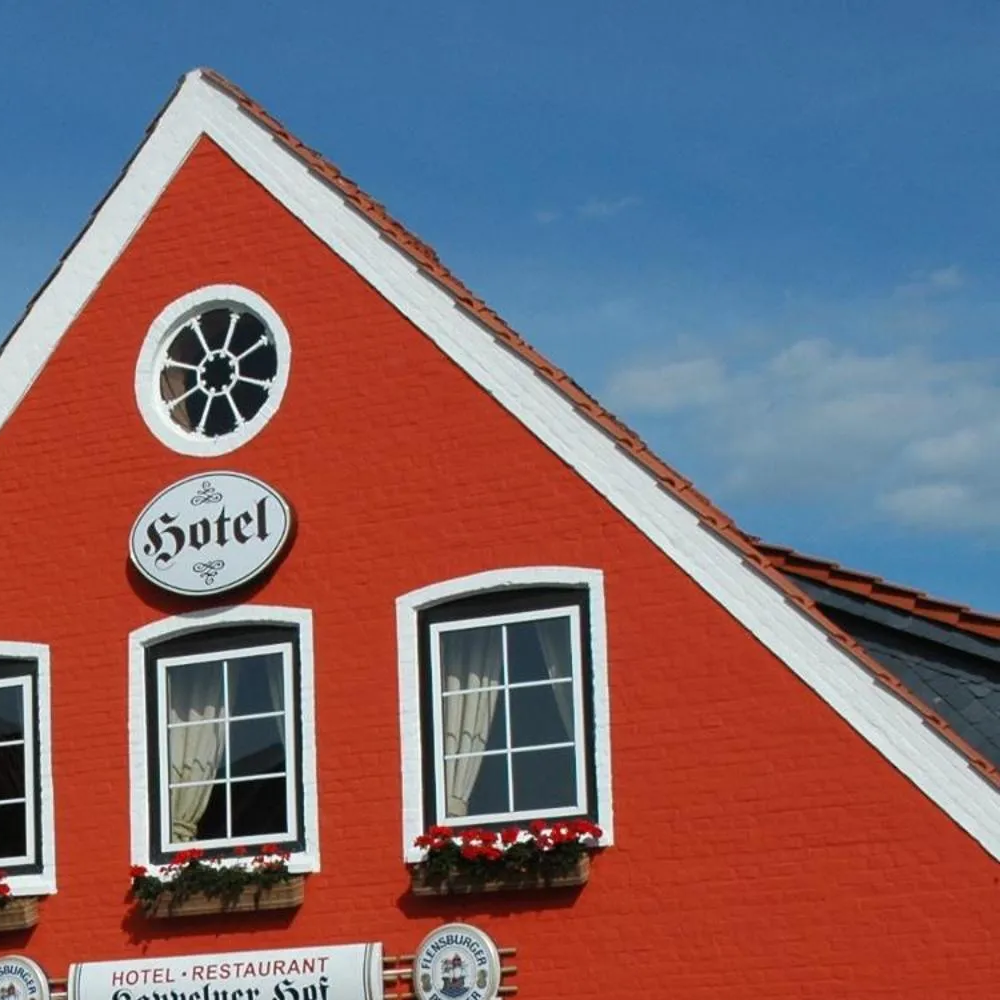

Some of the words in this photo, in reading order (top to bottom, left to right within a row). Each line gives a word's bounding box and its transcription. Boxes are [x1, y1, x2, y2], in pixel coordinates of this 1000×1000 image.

[143, 496, 270, 570] Hotel
[421, 933, 487, 969] FLENSBURGER
[112, 968, 175, 986] HOTEL
[192, 957, 329, 981] RESTAURANT
